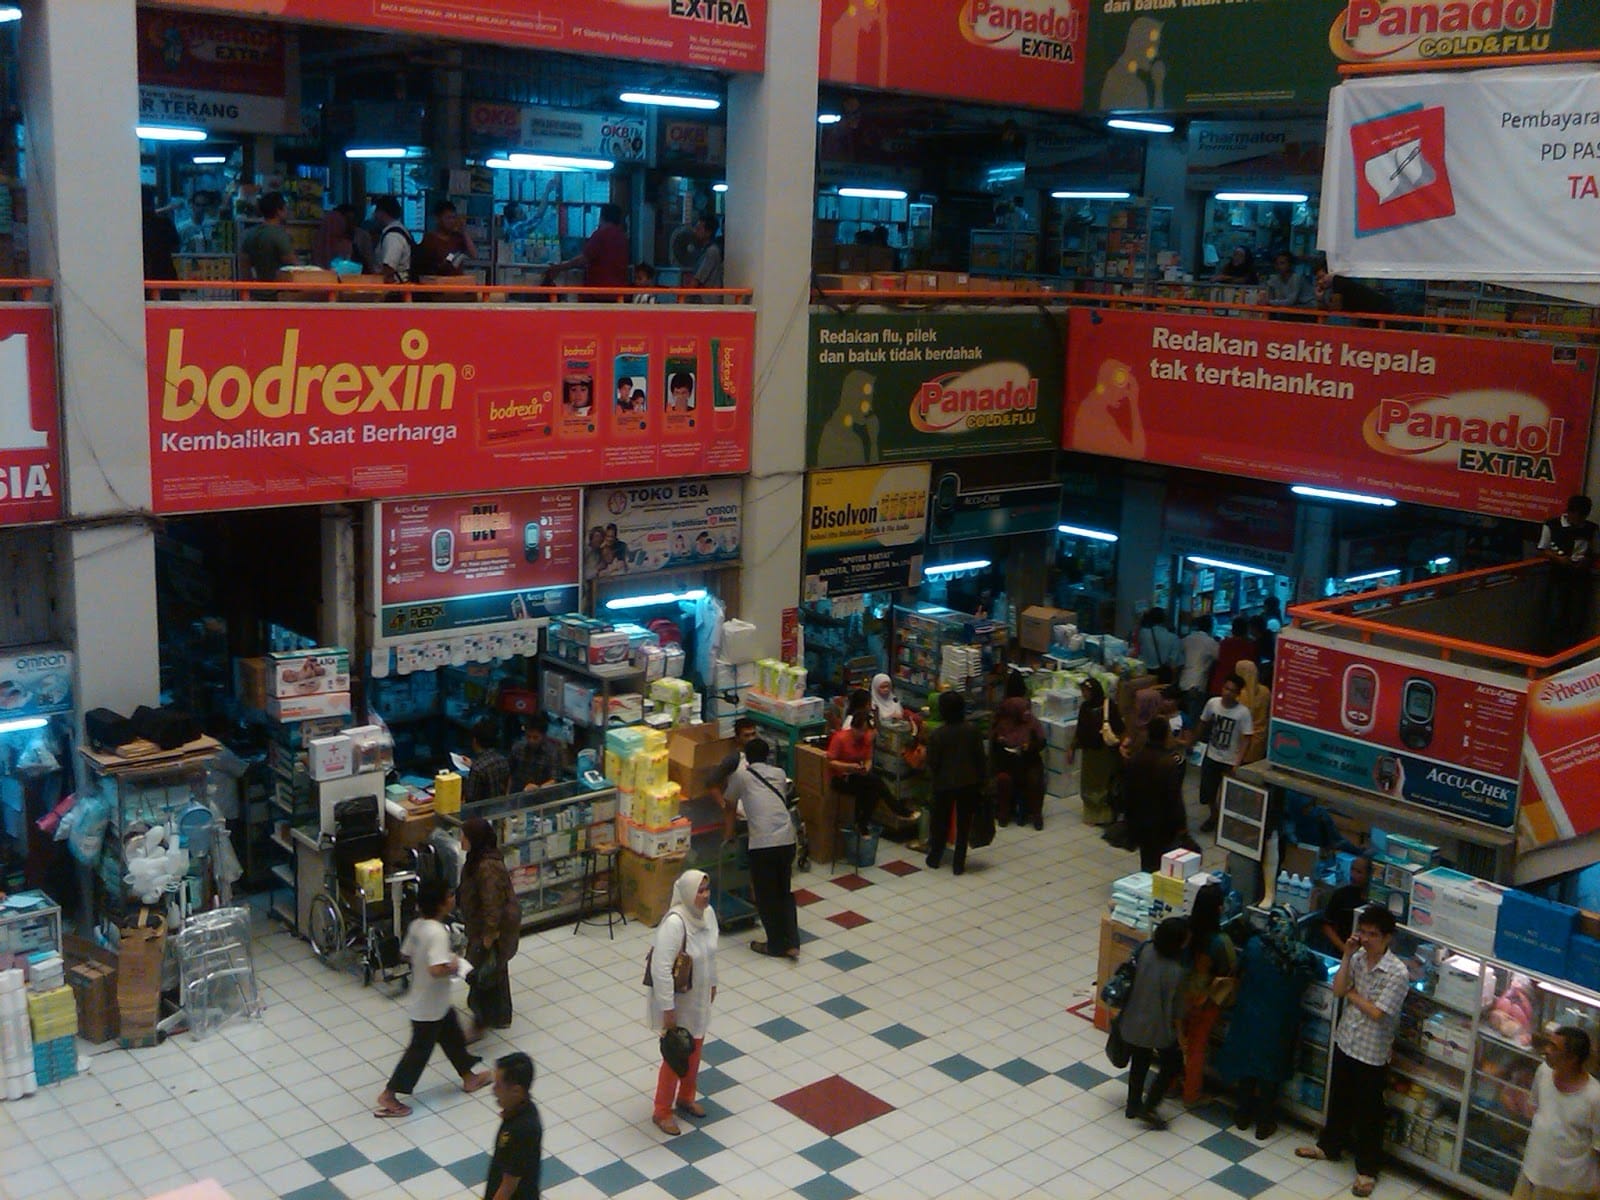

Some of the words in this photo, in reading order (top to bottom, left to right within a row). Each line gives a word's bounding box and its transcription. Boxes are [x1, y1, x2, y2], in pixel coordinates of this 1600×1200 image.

[669, 0, 751, 28] EXTRA
[969, 0, 1078, 41] Panadol
[1346, 0, 1554, 41] Panadol
[1020, 37, 1075, 63] EXTRA
[1418, 33, 1550, 58] COLD&FLU
[164, 100, 240, 119] TERANG
[1199, 129, 1286, 144] Pharmaton
[1541, 143, 1566, 161] PD
[819, 328, 879, 344] Redakan
[882, 328, 904, 345] flu,
[905, 328, 937, 346] pilek
[819, 349, 845, 364] dan
[848, 347, 886, 363] batuk
[890, 347, 922, 361] tidak
[925, 346, 983, 361] berdahak
[1151, 326, 1259, 358] Redakan
[1265, 339, 1333, 365] sakit
[1340, 342, 1437, 376] kepala
[162, 328, 457, 422] bodrexin
[1150, 357, 1188, 381] tak
[1194, 362, 1354, 400] tertahankan
[489, 398, 543, 421] bodrexin
[920, 378, 1039, 416] Panadol
[965, 411, 1036, 429] COLD&FLU
[1378, 398, 1565, 456] Panadol
[161, 427, 300, 453] Kembalikan
[308, 426, 355, 446] Saat
[362, 423, 458, 445] Berharga
[1457, 447, 1556, 484] EXTRA
[628, 487, 673, 502] TOKO
[678, 484, 709, 498] ESA
[811, 503, 878, 530] Bisolvon
[1425, 767, 1510, 801] ACCU-CHEK
